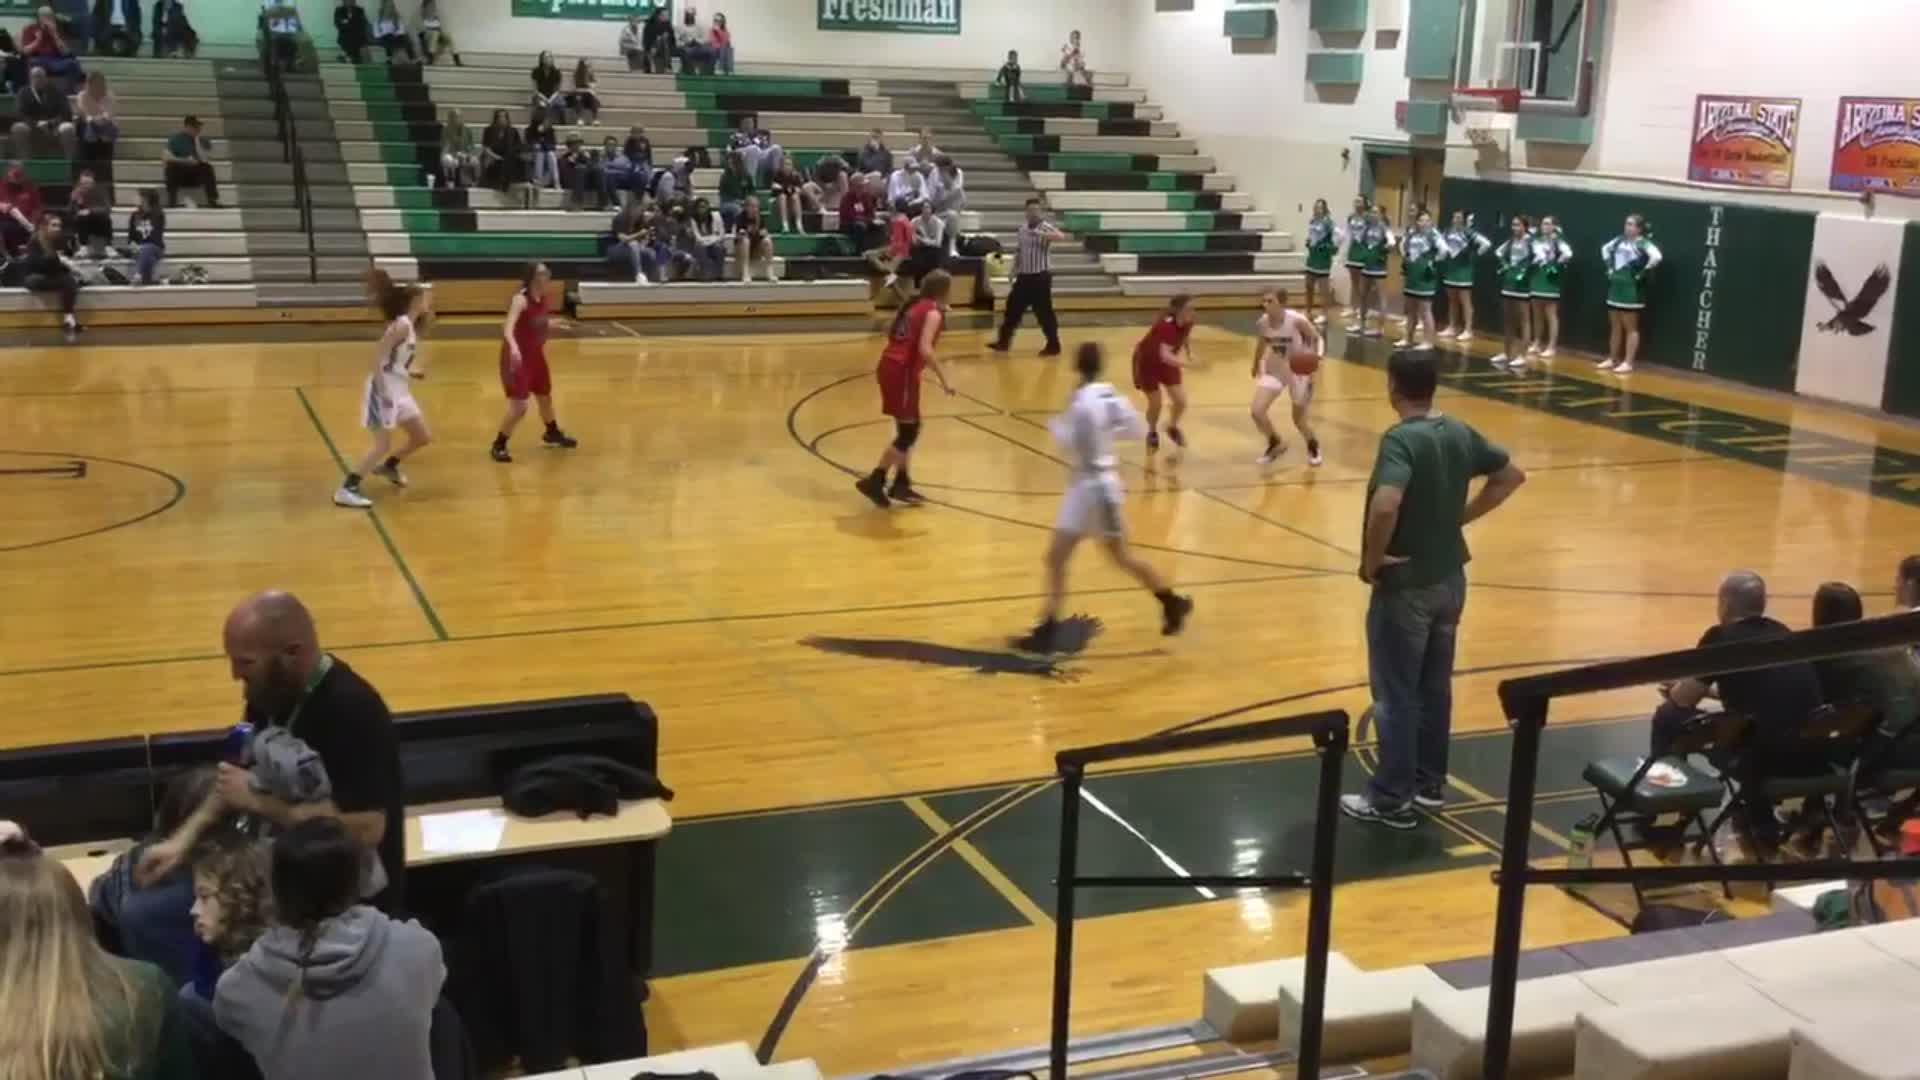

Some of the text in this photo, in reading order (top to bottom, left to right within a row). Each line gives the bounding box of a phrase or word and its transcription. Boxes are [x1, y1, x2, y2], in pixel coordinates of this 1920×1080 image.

[822, 0, 957, 23] Freshman
[1757, 103, 1798, 150] STATE
[1840, 103, 1904, 150] ARIZONA
[1692, 206, 1723, 369] THATCHER
